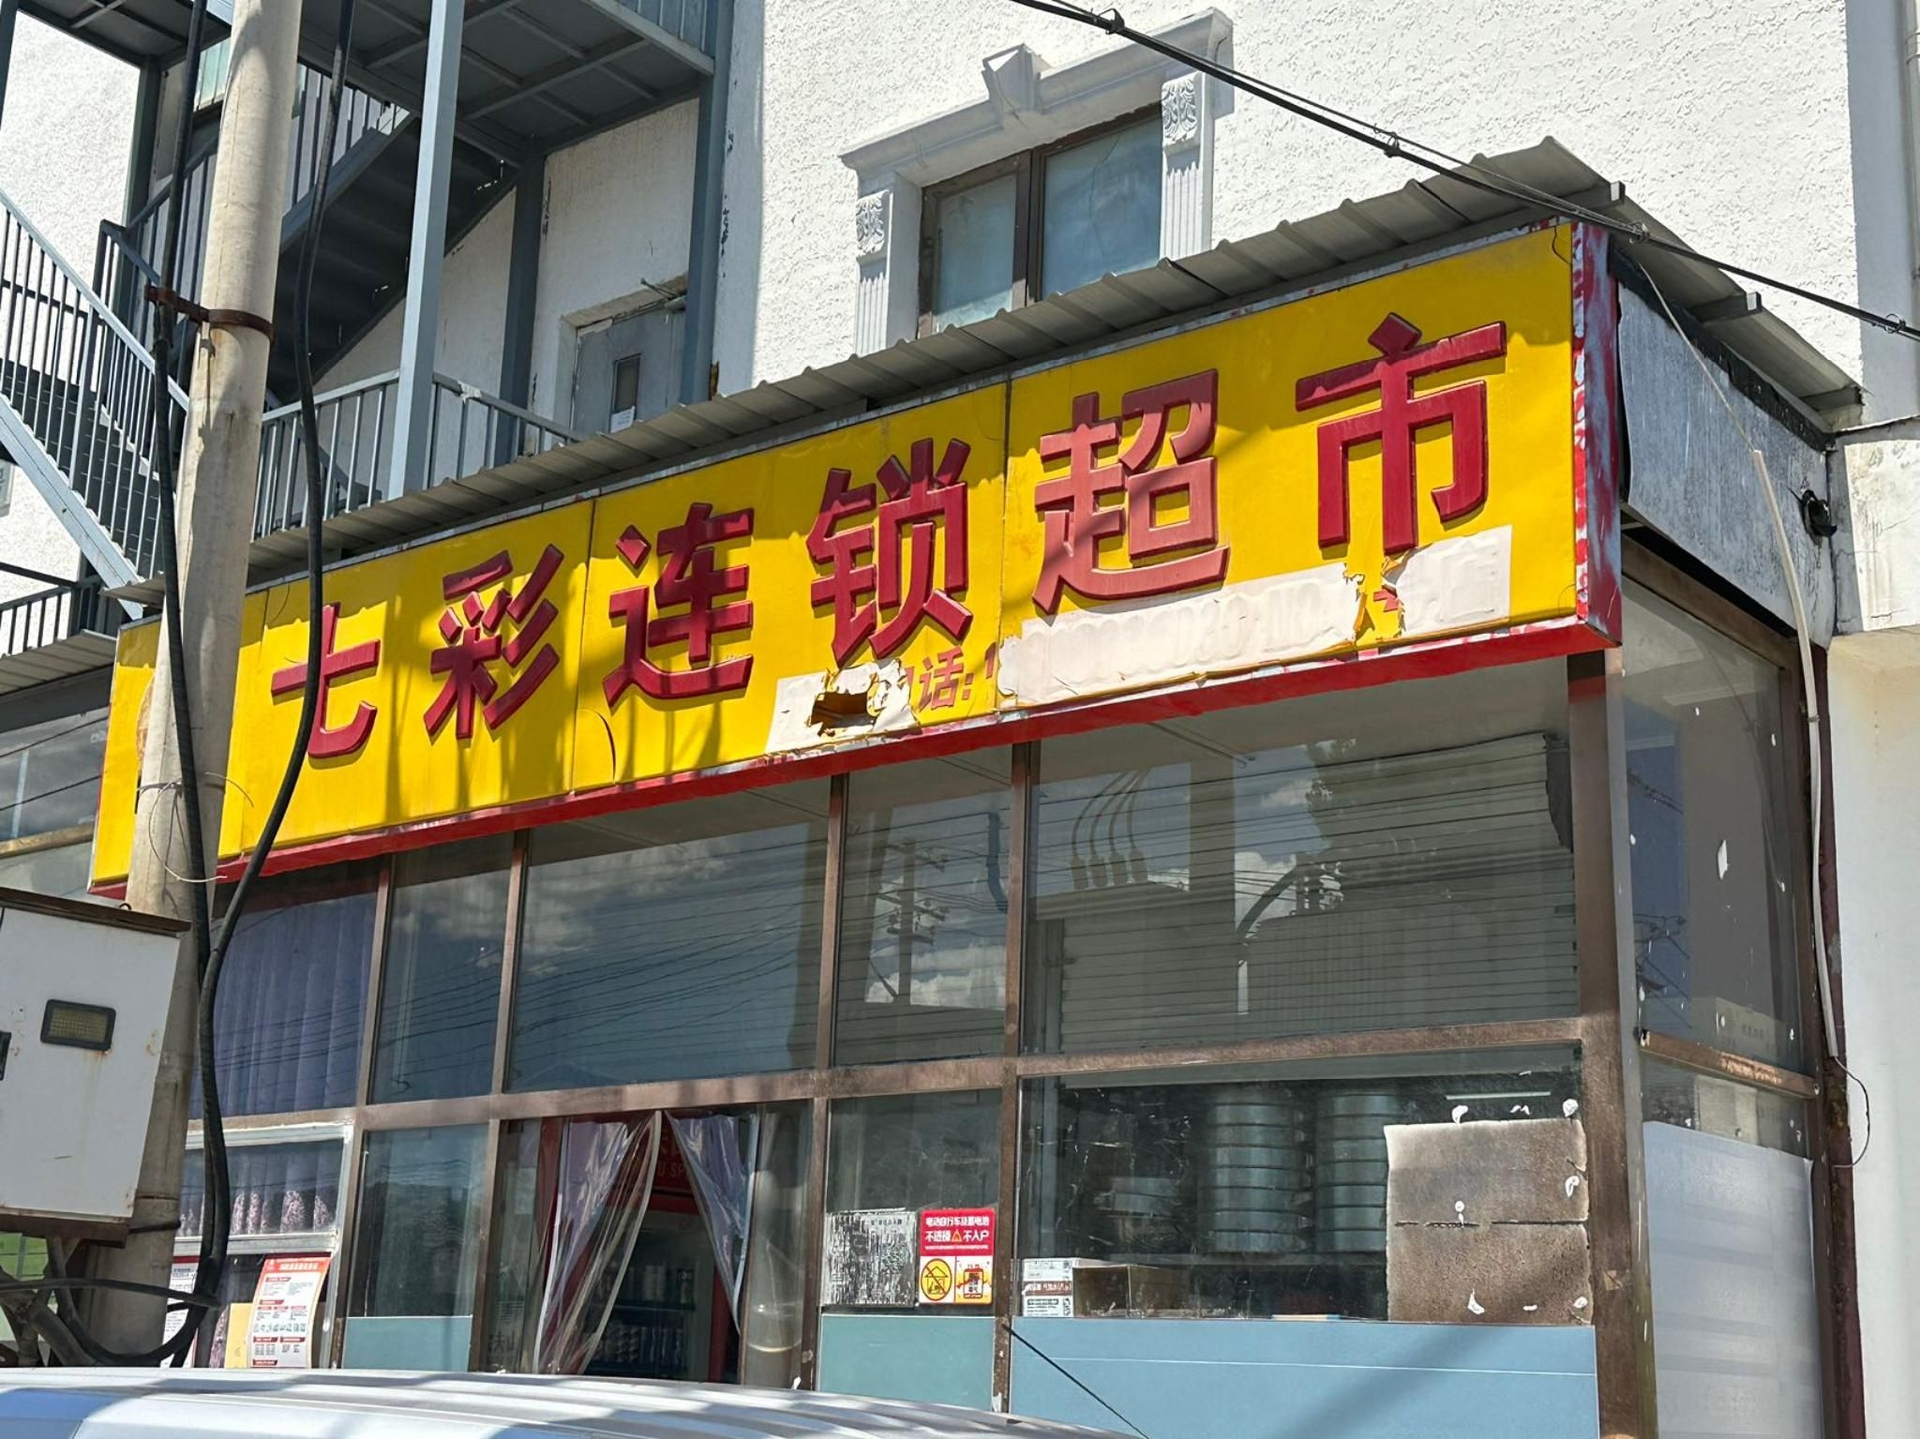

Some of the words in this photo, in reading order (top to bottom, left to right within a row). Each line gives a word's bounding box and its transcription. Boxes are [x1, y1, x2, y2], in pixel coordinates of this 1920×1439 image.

[271, 312, 1507, 759] 七彩连锁超市
